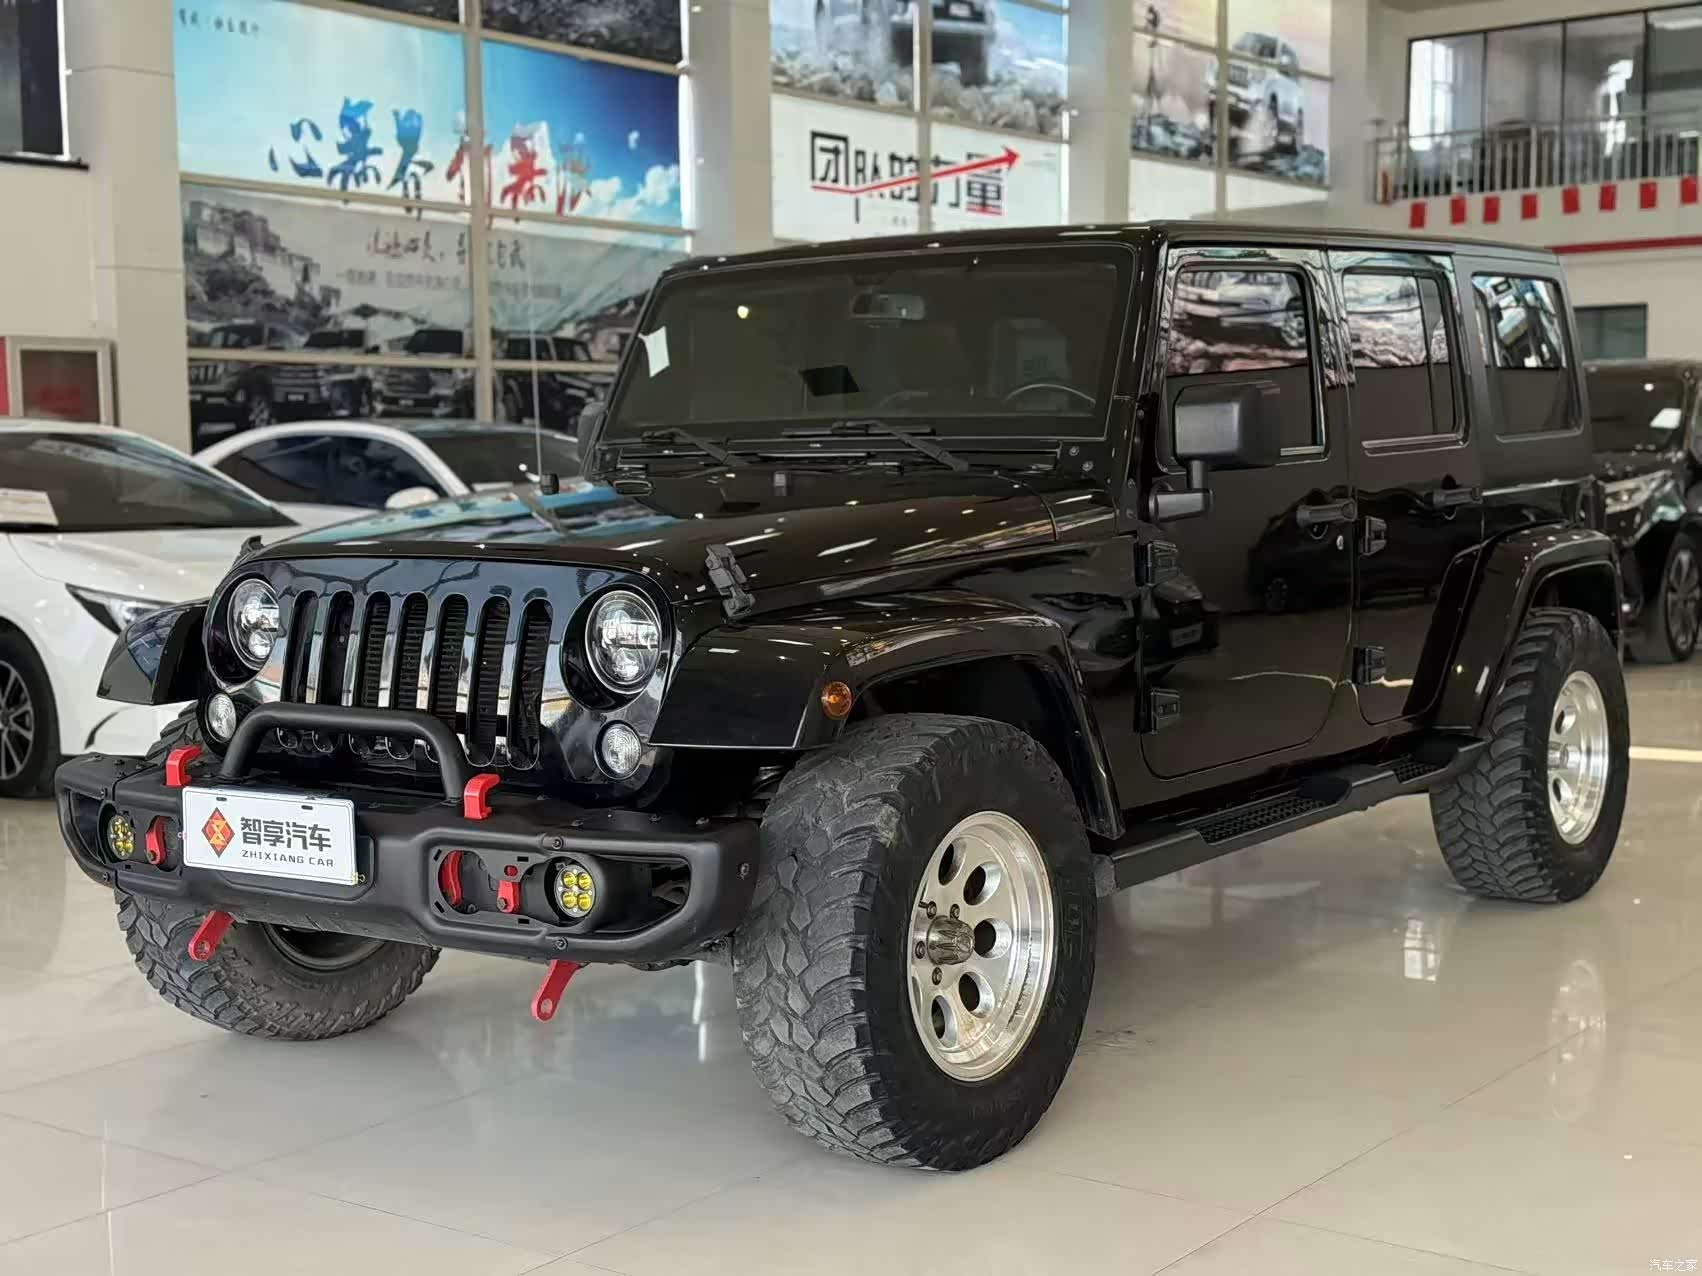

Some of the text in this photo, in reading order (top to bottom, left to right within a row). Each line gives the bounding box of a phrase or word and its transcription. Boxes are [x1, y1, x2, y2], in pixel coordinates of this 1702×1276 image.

[240, 817, 332, 851] 智享汽车
[242, 850, 335, 868] ZHIXIANG CAR
